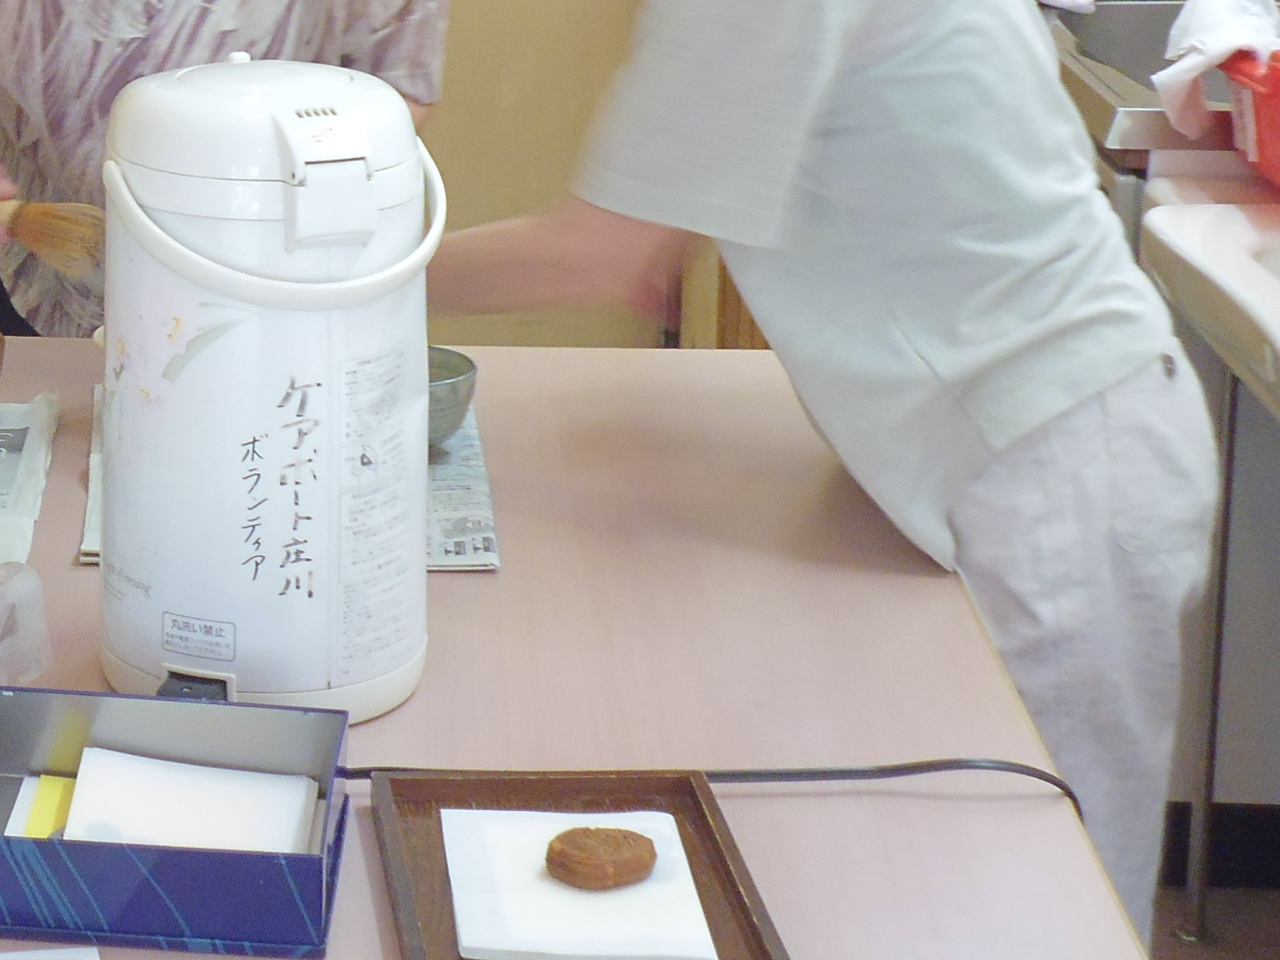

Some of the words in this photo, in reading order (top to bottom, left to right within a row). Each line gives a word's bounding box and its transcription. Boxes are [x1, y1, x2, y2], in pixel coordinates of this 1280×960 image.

[241, 434, 269, 581] ボランティア
[170, 618, 226, 638] 丸洗い禁止
